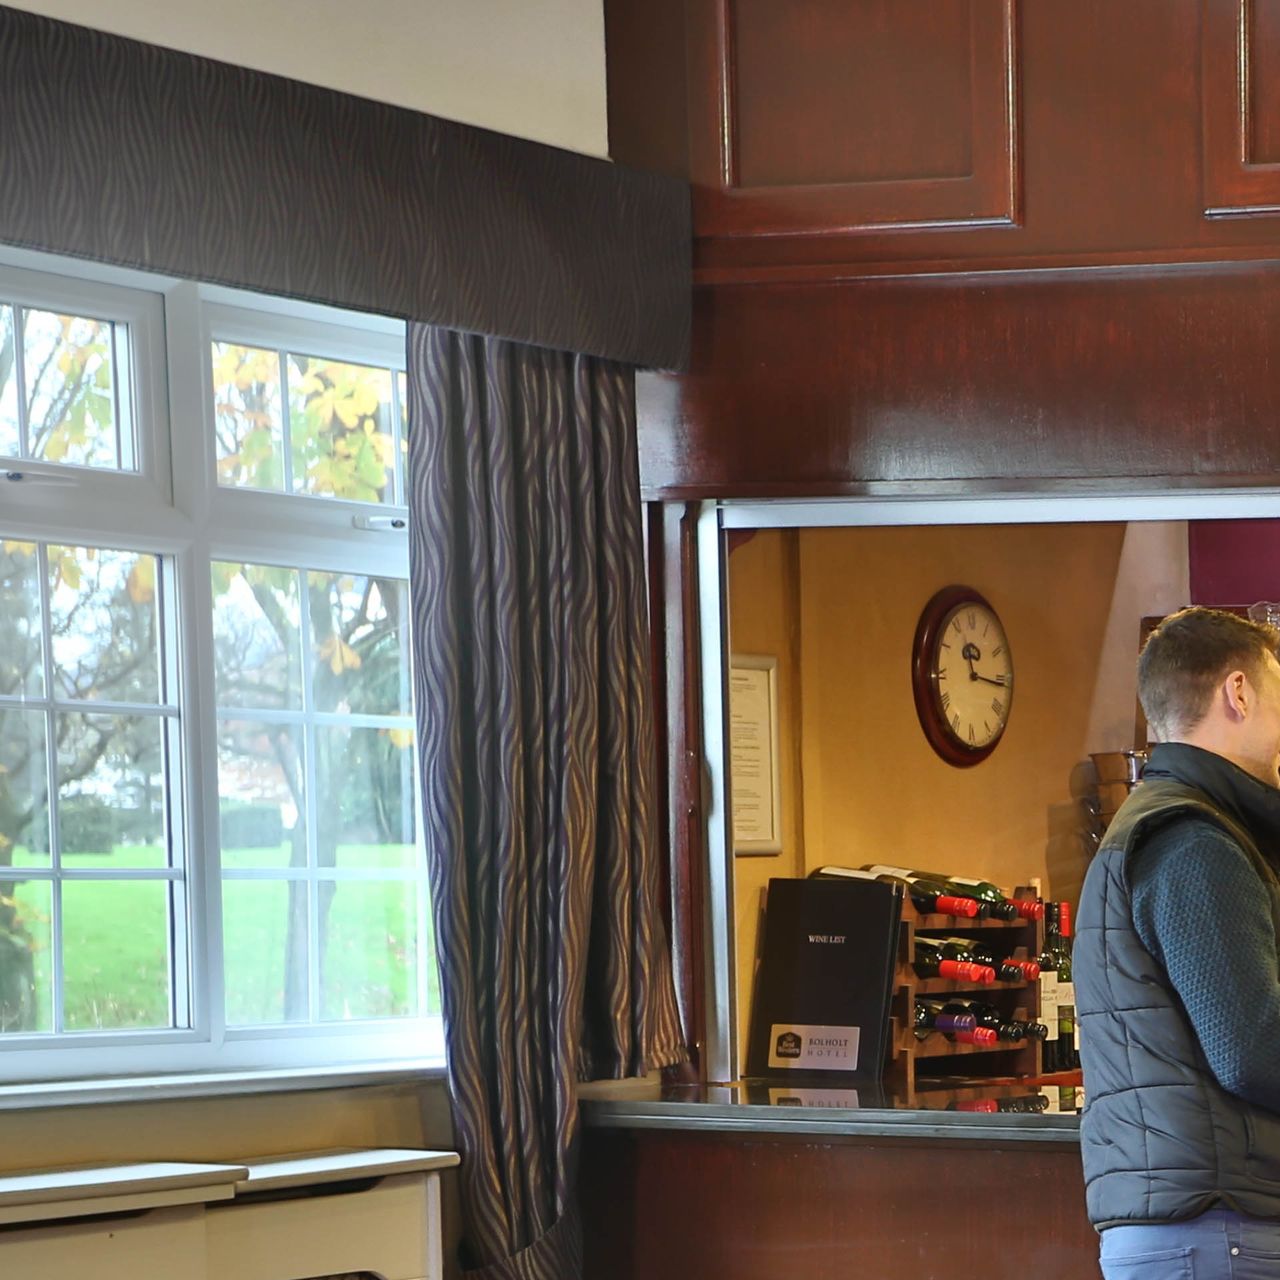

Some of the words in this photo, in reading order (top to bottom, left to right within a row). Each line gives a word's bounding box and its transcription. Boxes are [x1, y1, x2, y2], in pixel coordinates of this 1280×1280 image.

[808, 935, 829, 943] WINE
[809, 1038, 849, 1047] BOLHOLT
[807, 1050, 848, 1058] HOTEL
